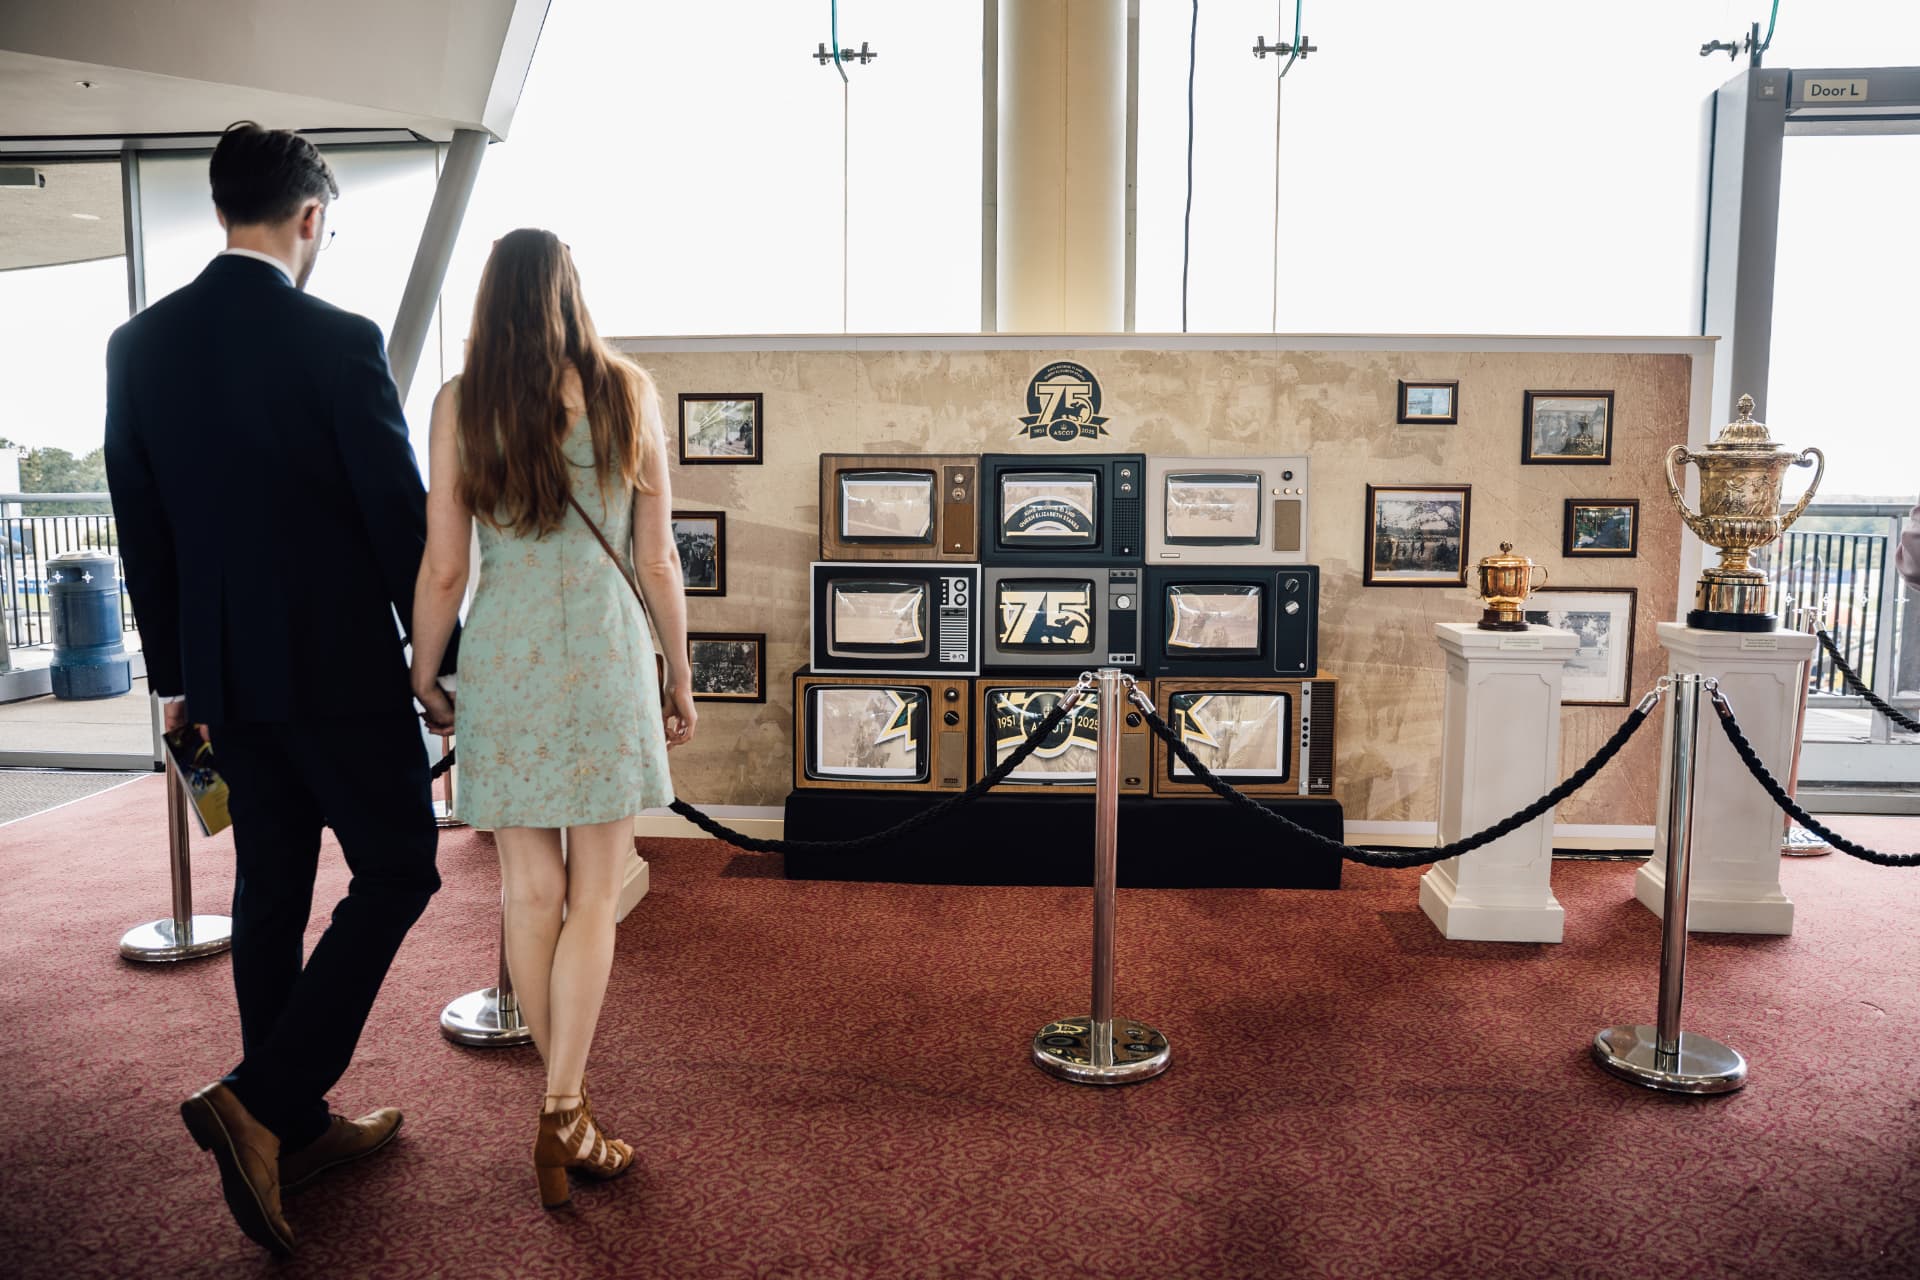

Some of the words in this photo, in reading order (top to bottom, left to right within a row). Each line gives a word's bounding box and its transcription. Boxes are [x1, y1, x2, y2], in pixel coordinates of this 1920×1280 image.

[1811, 84, 1847, 96] Door
[1850, 83, 1860, 96] L
[1036, 382, 1093, 424] 75
[1000, 591, 1090, 643] 75
[997, 714, 1016, 729] 1951
